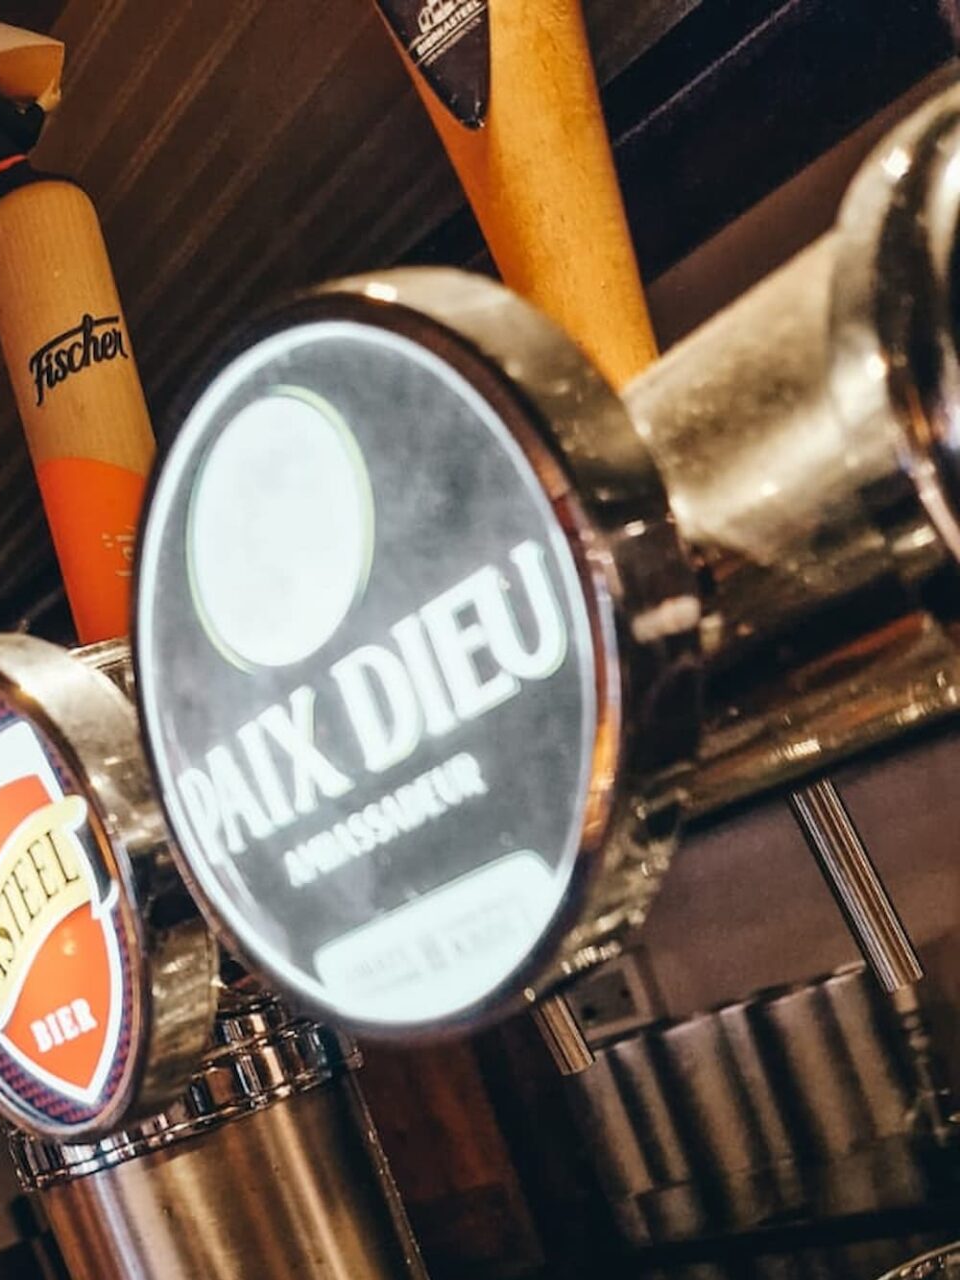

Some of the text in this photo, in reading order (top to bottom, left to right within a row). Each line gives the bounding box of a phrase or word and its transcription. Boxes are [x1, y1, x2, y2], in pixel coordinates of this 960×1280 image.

[28, 314, 128, 407] Fischer
[178, 539, 568, 866] PAIX DIEU
[30, 998, 99, 1054] BIER
